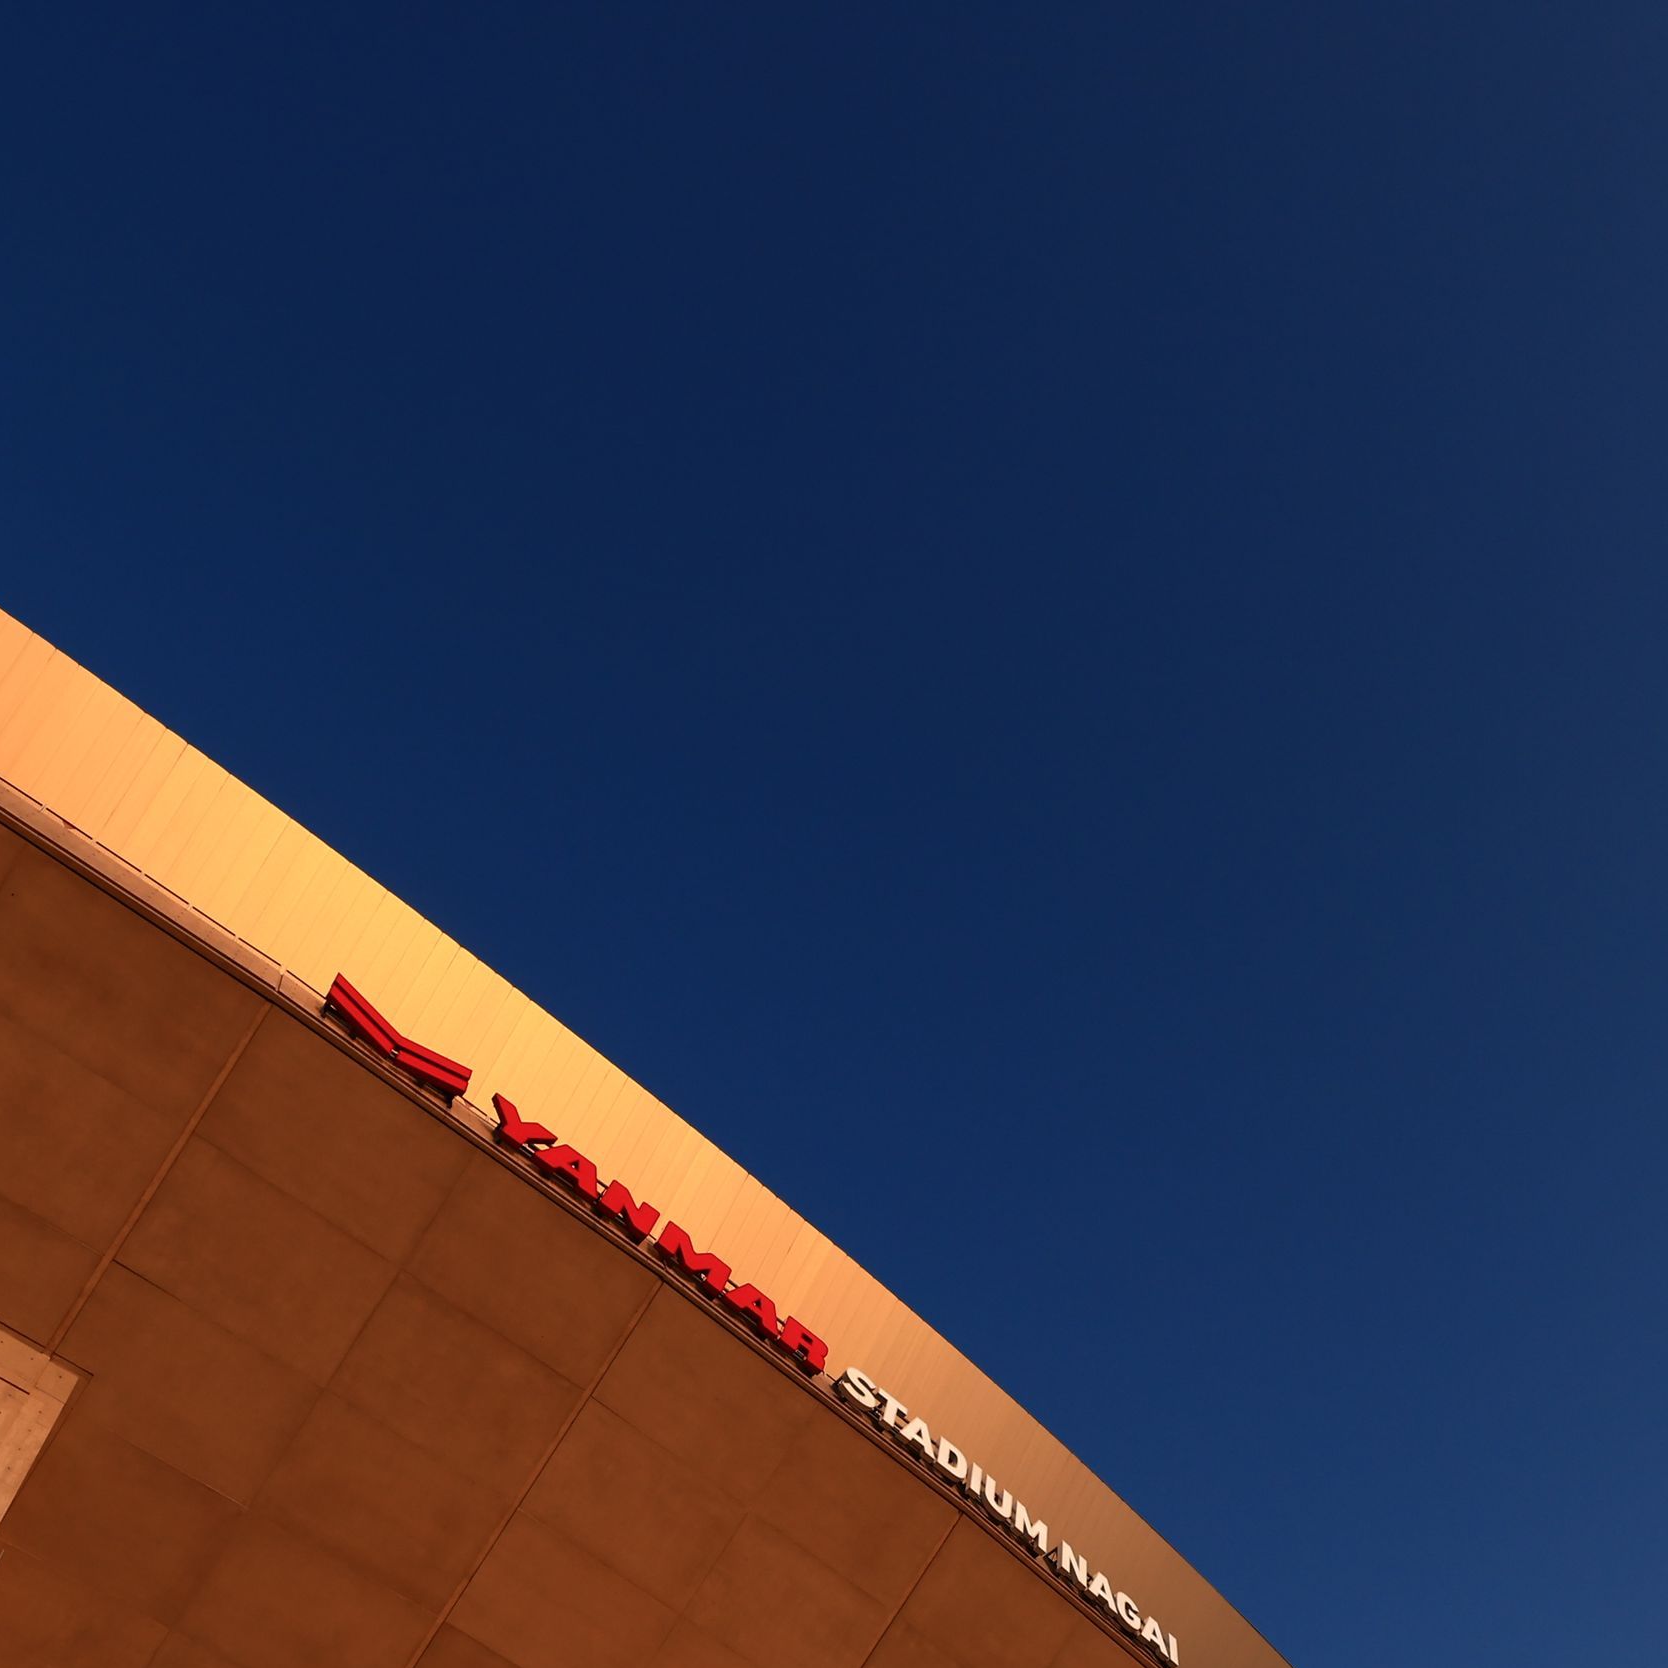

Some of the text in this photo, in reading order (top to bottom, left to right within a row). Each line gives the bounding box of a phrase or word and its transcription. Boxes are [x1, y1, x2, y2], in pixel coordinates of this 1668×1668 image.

[491, 1093, 1180, 1667] YANMAR STADIUM NAGAI
